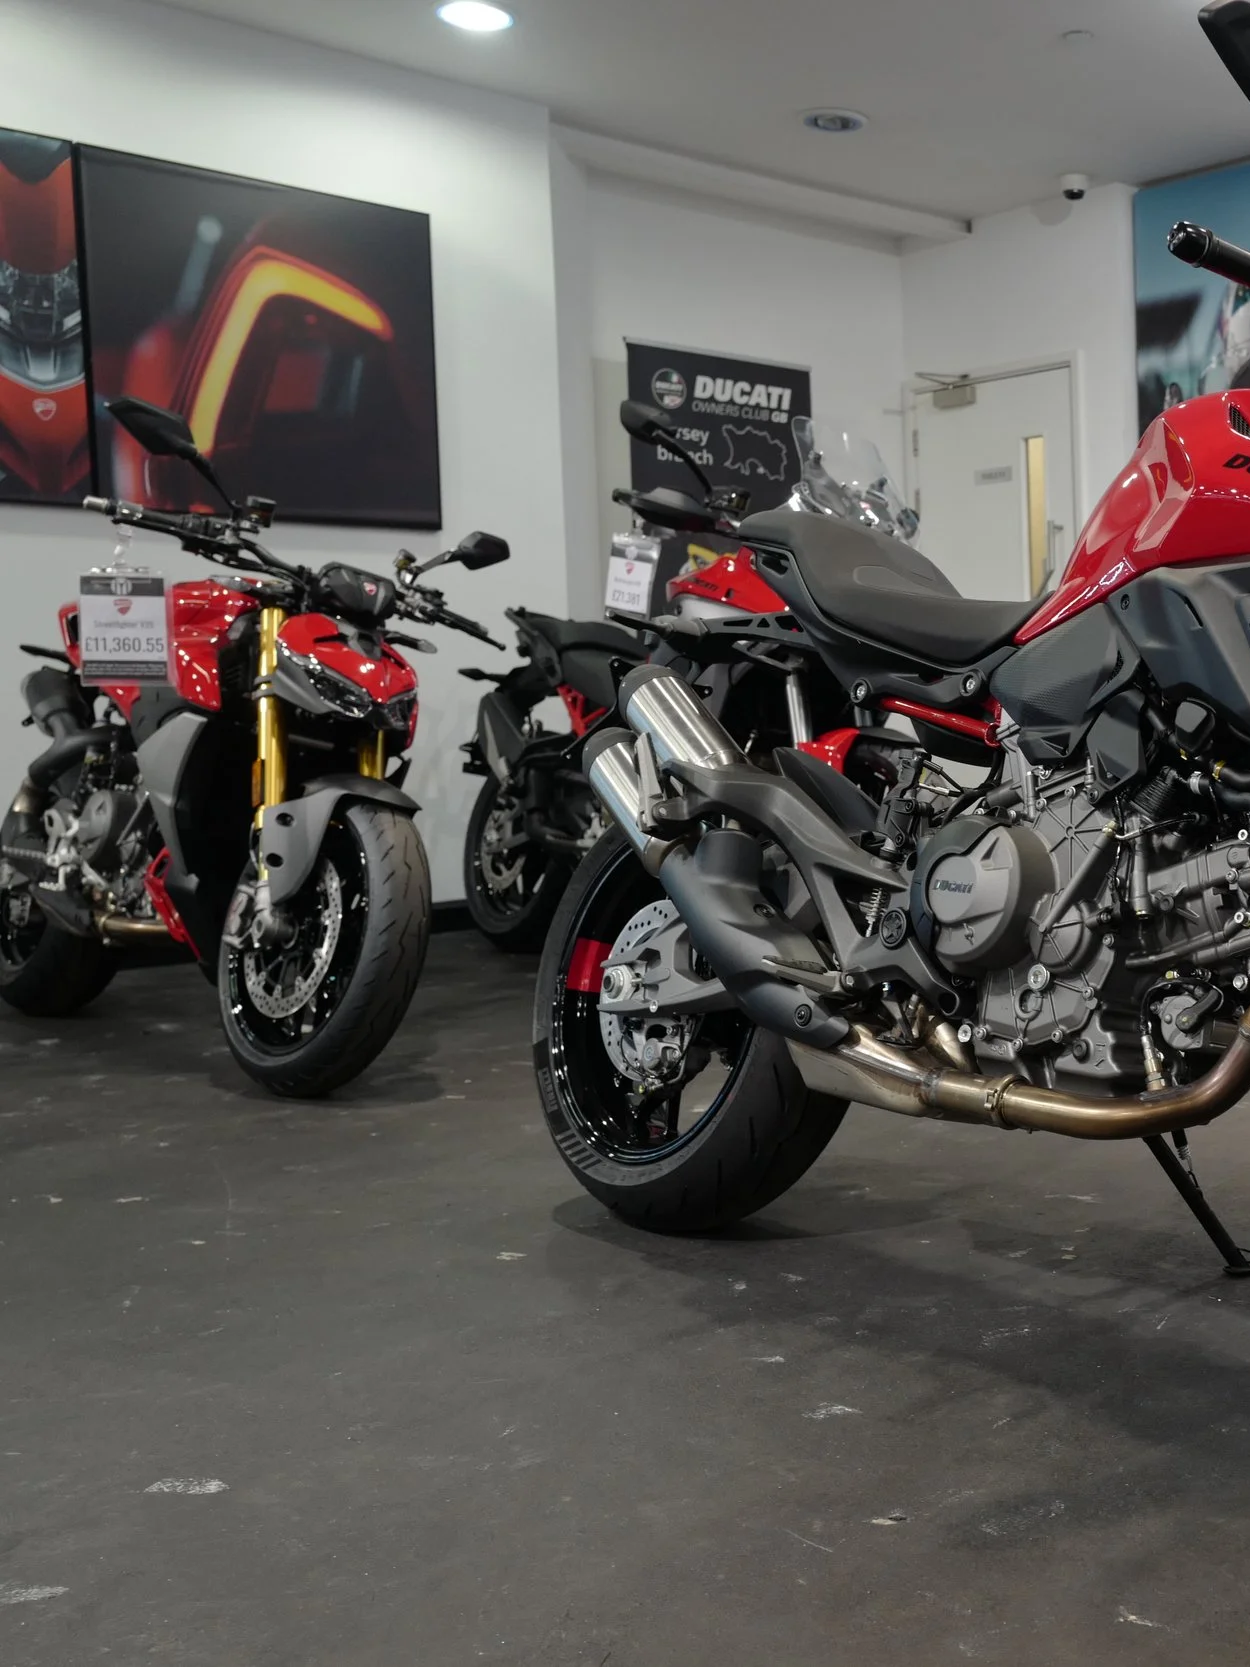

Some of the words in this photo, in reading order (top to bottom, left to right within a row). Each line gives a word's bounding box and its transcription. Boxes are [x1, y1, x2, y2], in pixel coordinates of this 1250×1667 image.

[694, 374, 792, 411] DUCATI
[692, 400, 740, 418] OWNERS
[741, 406, 770, 421] CLUB
[771, 411, 789, 424] GB
[85, 636, 164, 654] £11,360.55
[933, 879, 975, 894] DUCATI
